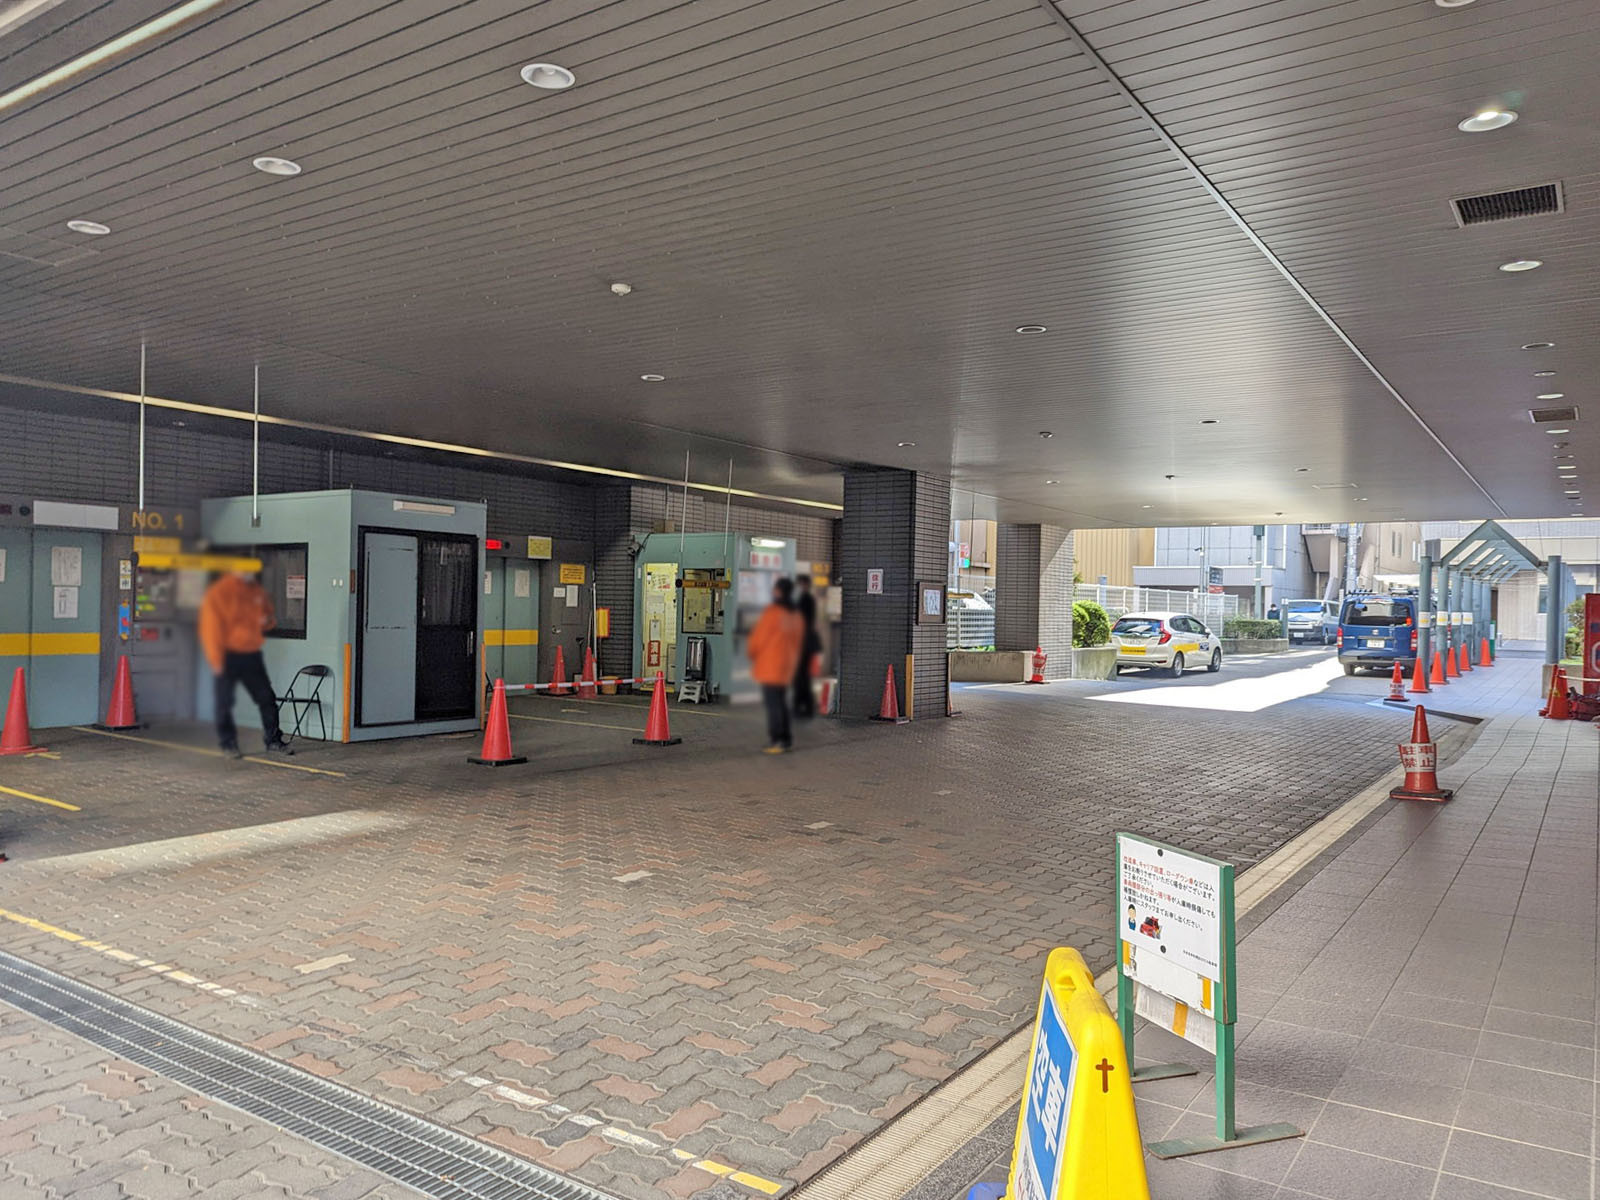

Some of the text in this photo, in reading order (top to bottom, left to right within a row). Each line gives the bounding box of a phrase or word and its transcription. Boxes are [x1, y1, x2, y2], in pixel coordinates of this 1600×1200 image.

[132, 511, 184, 530] NO. 1
[1402, 745, 1434, 755] 駐車
[1403, 758, 1434, 768] 禁止
[1031, 1028, 1066, 1156] 空車
